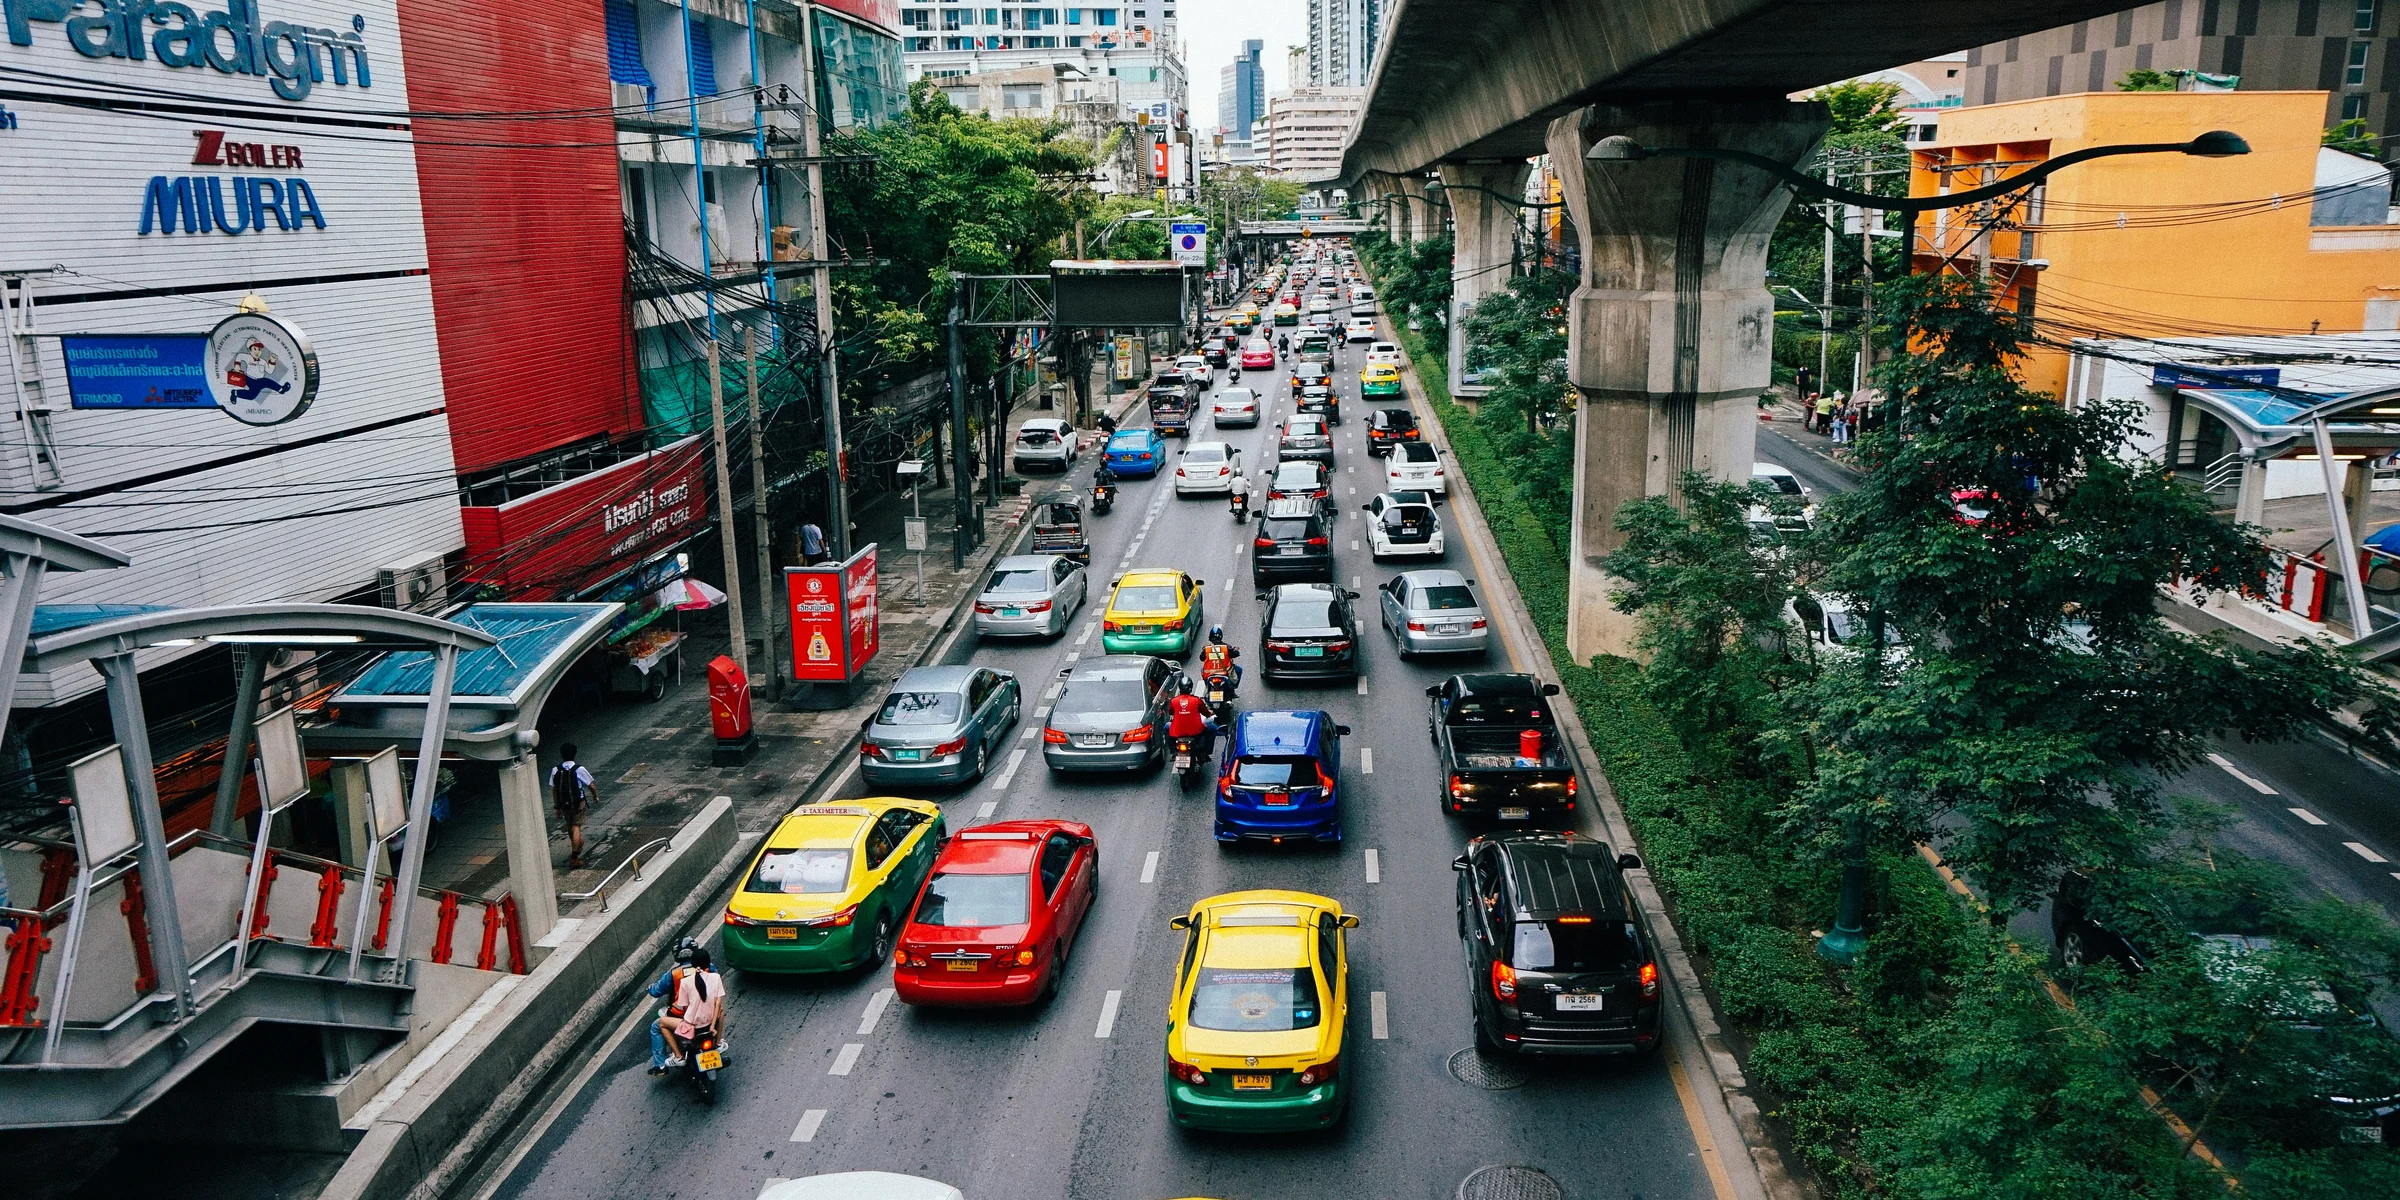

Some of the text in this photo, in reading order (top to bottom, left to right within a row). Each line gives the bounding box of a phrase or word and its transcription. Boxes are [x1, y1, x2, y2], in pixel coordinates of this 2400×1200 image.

[138, 176, 327, 235] MIURA
[262, 329, 277, 340] PARTS
[163, 388, 204, 396] MITSUBISHI
[77, 393, 123, 404] TRIMOND
[163, 395, 199, 403] ELECTRIC
[1251, 1075, 1270, 1084] 7970
